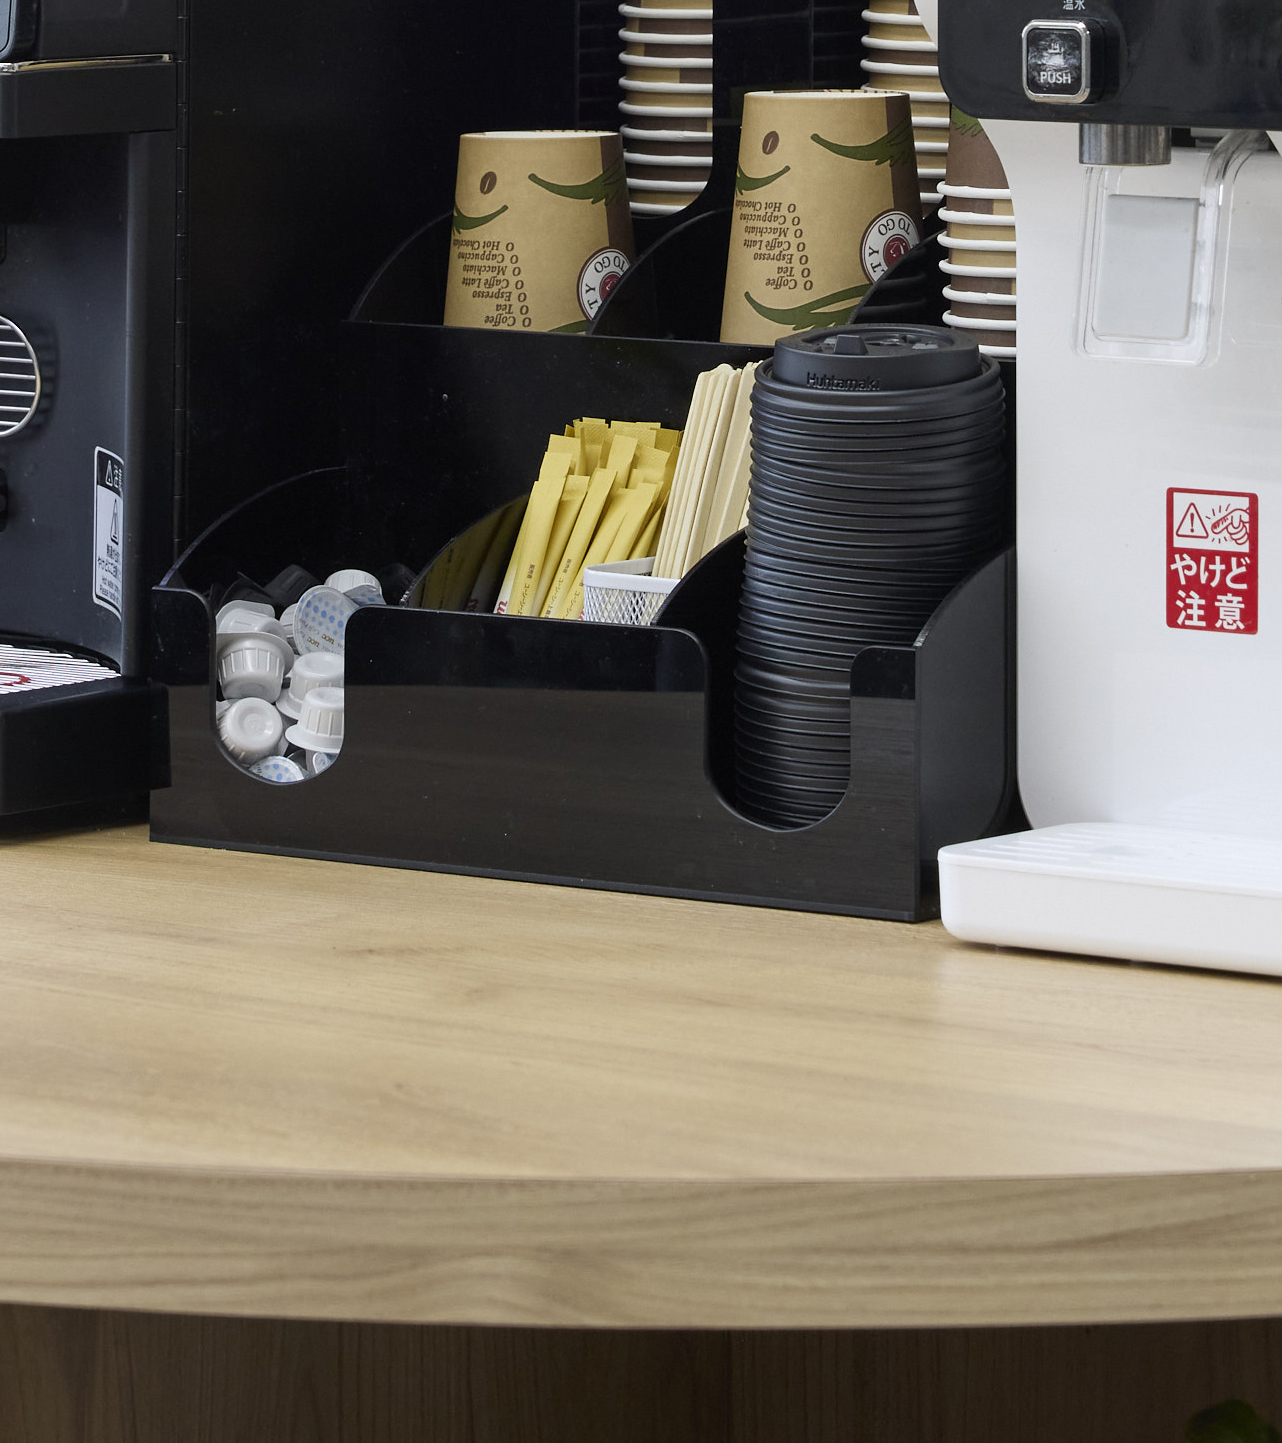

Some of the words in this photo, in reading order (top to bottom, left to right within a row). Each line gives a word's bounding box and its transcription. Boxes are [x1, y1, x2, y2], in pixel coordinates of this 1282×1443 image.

[1040, 71, 1072, 84] PUSH
[763, 201, 782, 212] Hot
[739, 212, 786, 224] Cappuccino
[744, 226, 789, 238] Macchiato
[878, 218, 896, 236] GO
[898, 217, 911, 235] TO
[482, 241, 500, 250] Hot
[744, 239, 763, 249] Latte
[457, 251, 505, 263] Cappuccino
[753, 251, 794, 264] Espresso
[462, 264, 508, 276] Macchiato
[593, 256, 611, 274] GO
[613, 256, 626, 272] TO
[777, 266, 795, 276] Tea
[461, 277, 482, 287] Latte
[765, 277, 798, 290] Coffee
[472, 290, 513, 301] Espresso
[495, 303, 514, 314] Tea
[484, 315, 516, 327] Coffee
[806, 371, 881, 391] Huhtamaki
[1169, 552, 1251, 590] やけど
[1175, 589, 1246, 630] 注意
